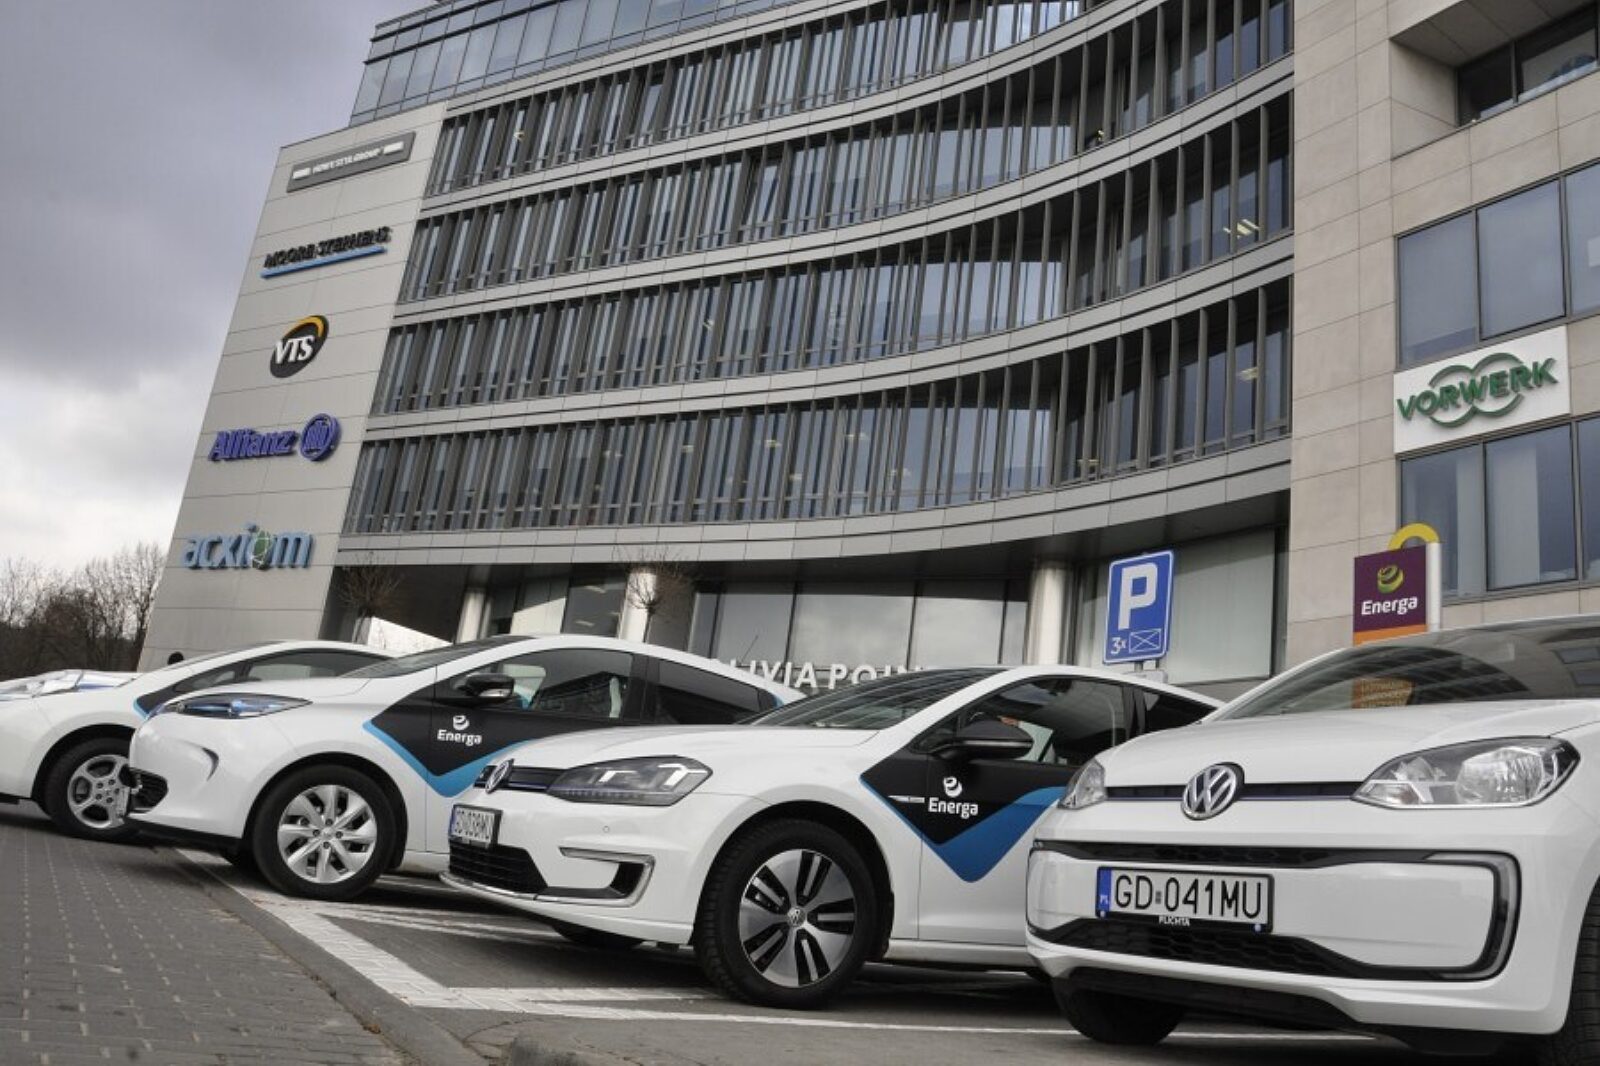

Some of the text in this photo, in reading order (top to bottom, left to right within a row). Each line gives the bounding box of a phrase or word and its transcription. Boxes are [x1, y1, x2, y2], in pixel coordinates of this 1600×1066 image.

[275, 335, 315, 364] VTS
[1397, 357, 1559, 421] VORWERK
[208, 428, 298, 461] Allianz
[183, 522, 314, 570] acxiom
[1118, 562, 1158, 631] P
[1361, 596, 1418, 615] Energa
[437, 729, 482, 746] Energa
[928, 797, 979, 819] Energa
